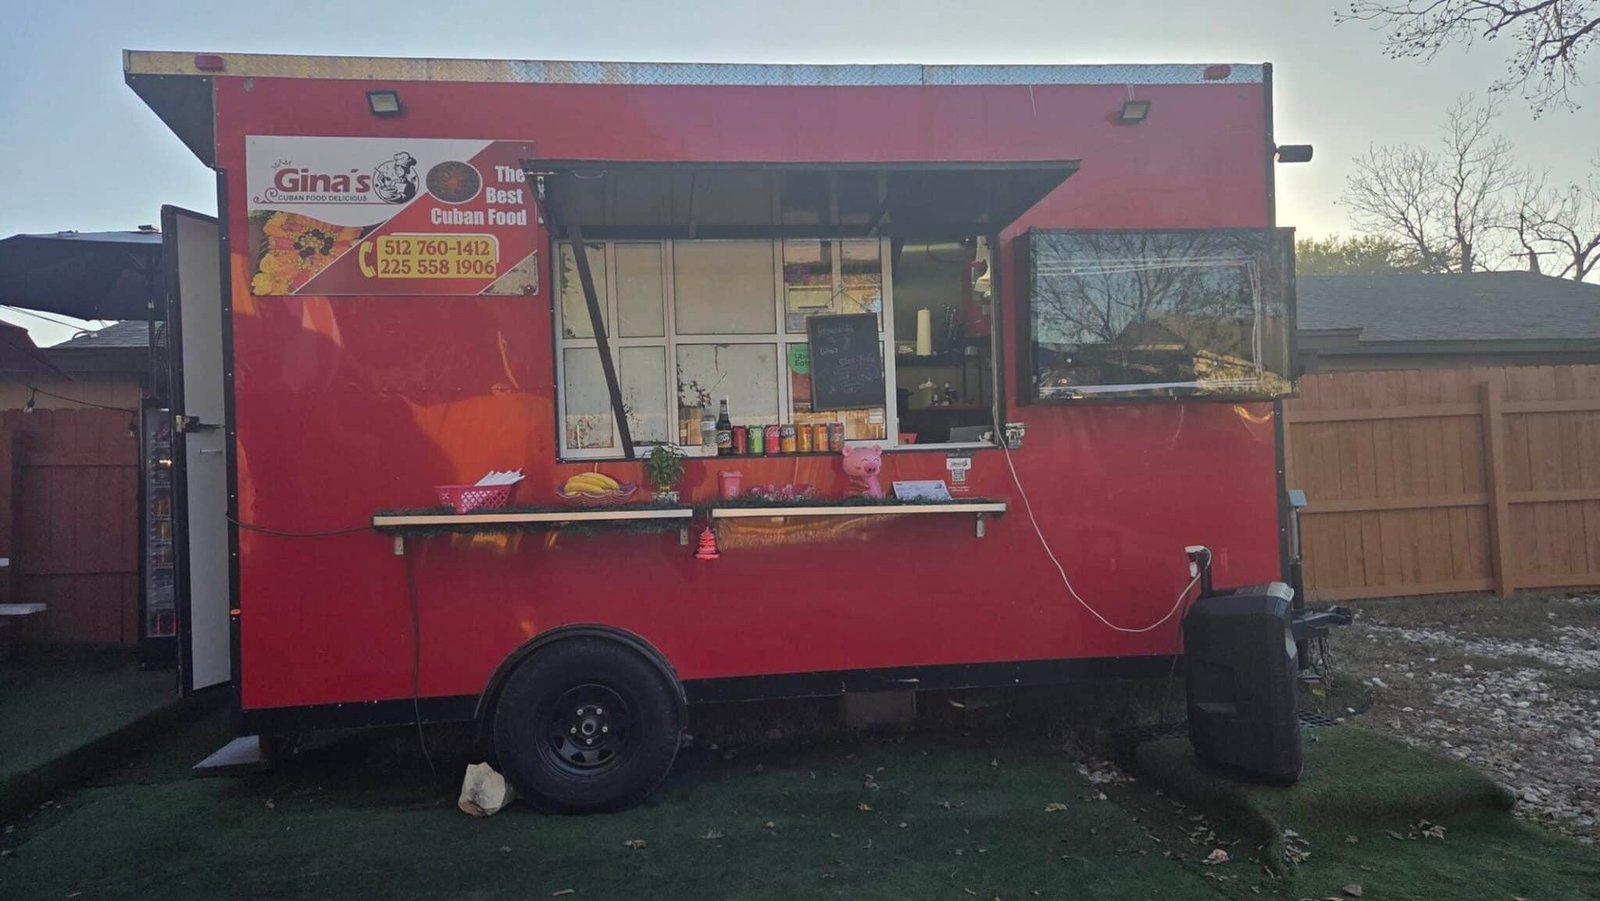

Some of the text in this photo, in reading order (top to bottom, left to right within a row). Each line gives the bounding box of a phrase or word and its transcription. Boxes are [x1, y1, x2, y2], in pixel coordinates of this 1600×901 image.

[496, 166, 525, 183] The
[486, 188, 523, 204] Best
[431, 208, 526, 226] Cuban Food
[385, 240, 489, 256] 512 760-1412
[381, 259, 495, 274] 225 558 1906
